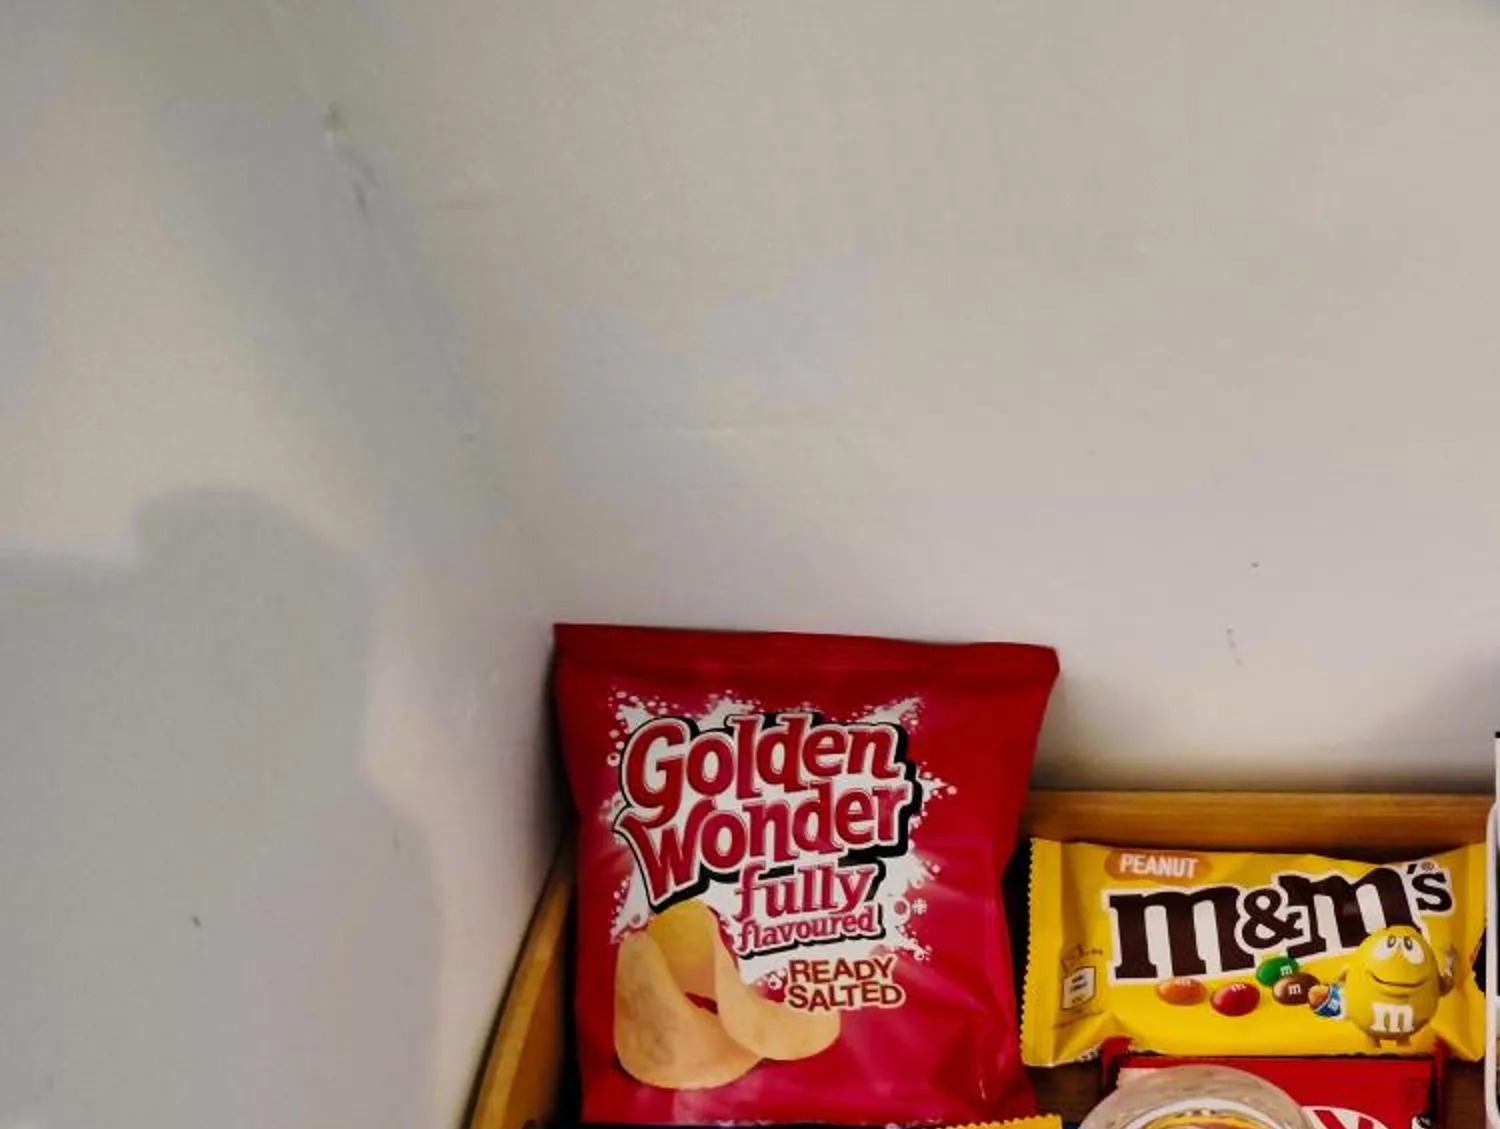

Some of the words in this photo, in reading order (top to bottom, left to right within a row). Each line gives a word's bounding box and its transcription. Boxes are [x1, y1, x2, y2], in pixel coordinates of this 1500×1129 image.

[622, 713, 903, 828] Golden
[616, 780, 911, 902] Wonder
[1118, 852, 1198, 878] PEANUT
[734, 864, 878, 922] fully
[735, 904, 880, 953] flavoured
[789, 954, 895, 984] READY
[786, 984, 904, 1010] SALTED
[1370, 1003, 1415, 1034] m
